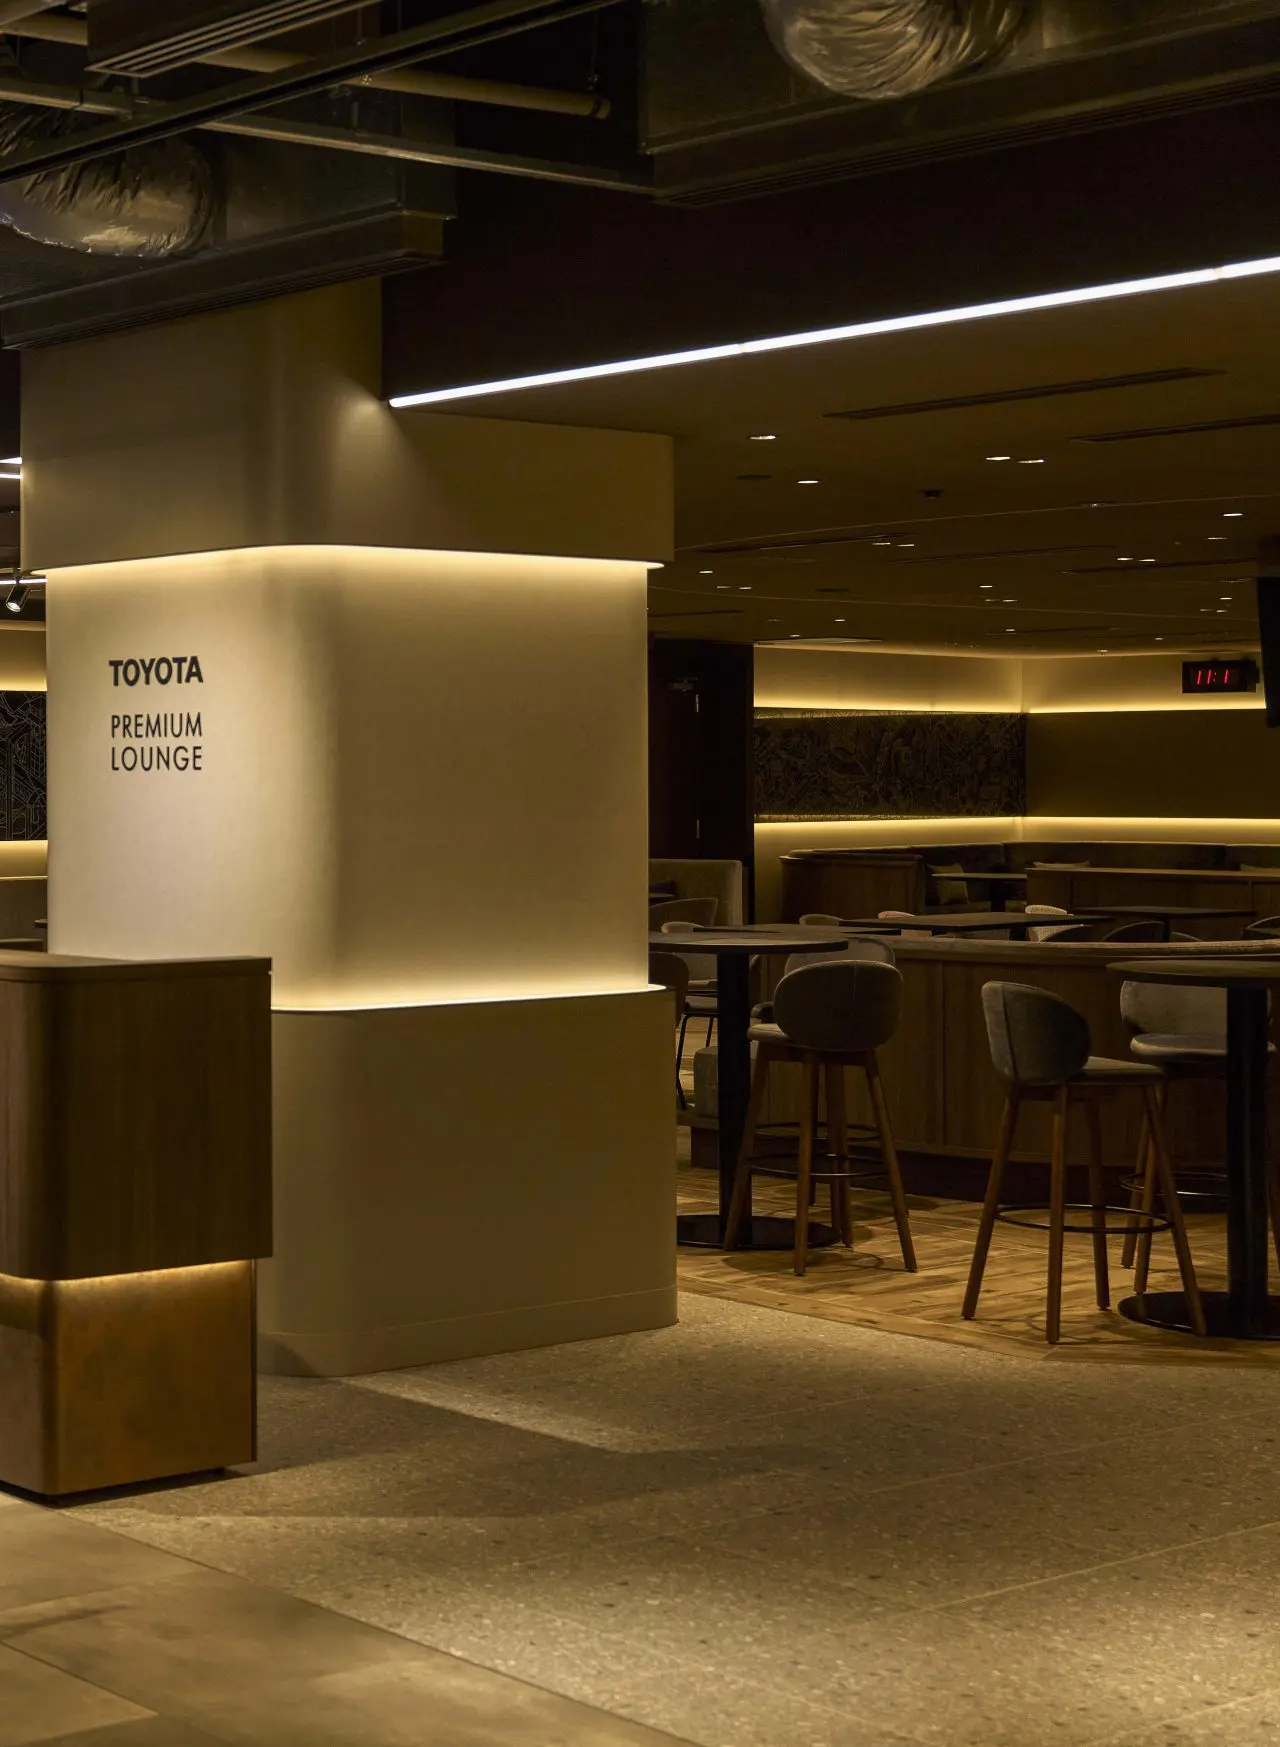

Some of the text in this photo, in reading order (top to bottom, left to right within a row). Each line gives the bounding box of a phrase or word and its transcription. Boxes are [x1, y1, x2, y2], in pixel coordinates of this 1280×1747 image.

[108, 655, 204, 687] TOYOTA
[111, 711, 202, 738] PREMIUM
[111, 745, 202, 771] LOUNGE
